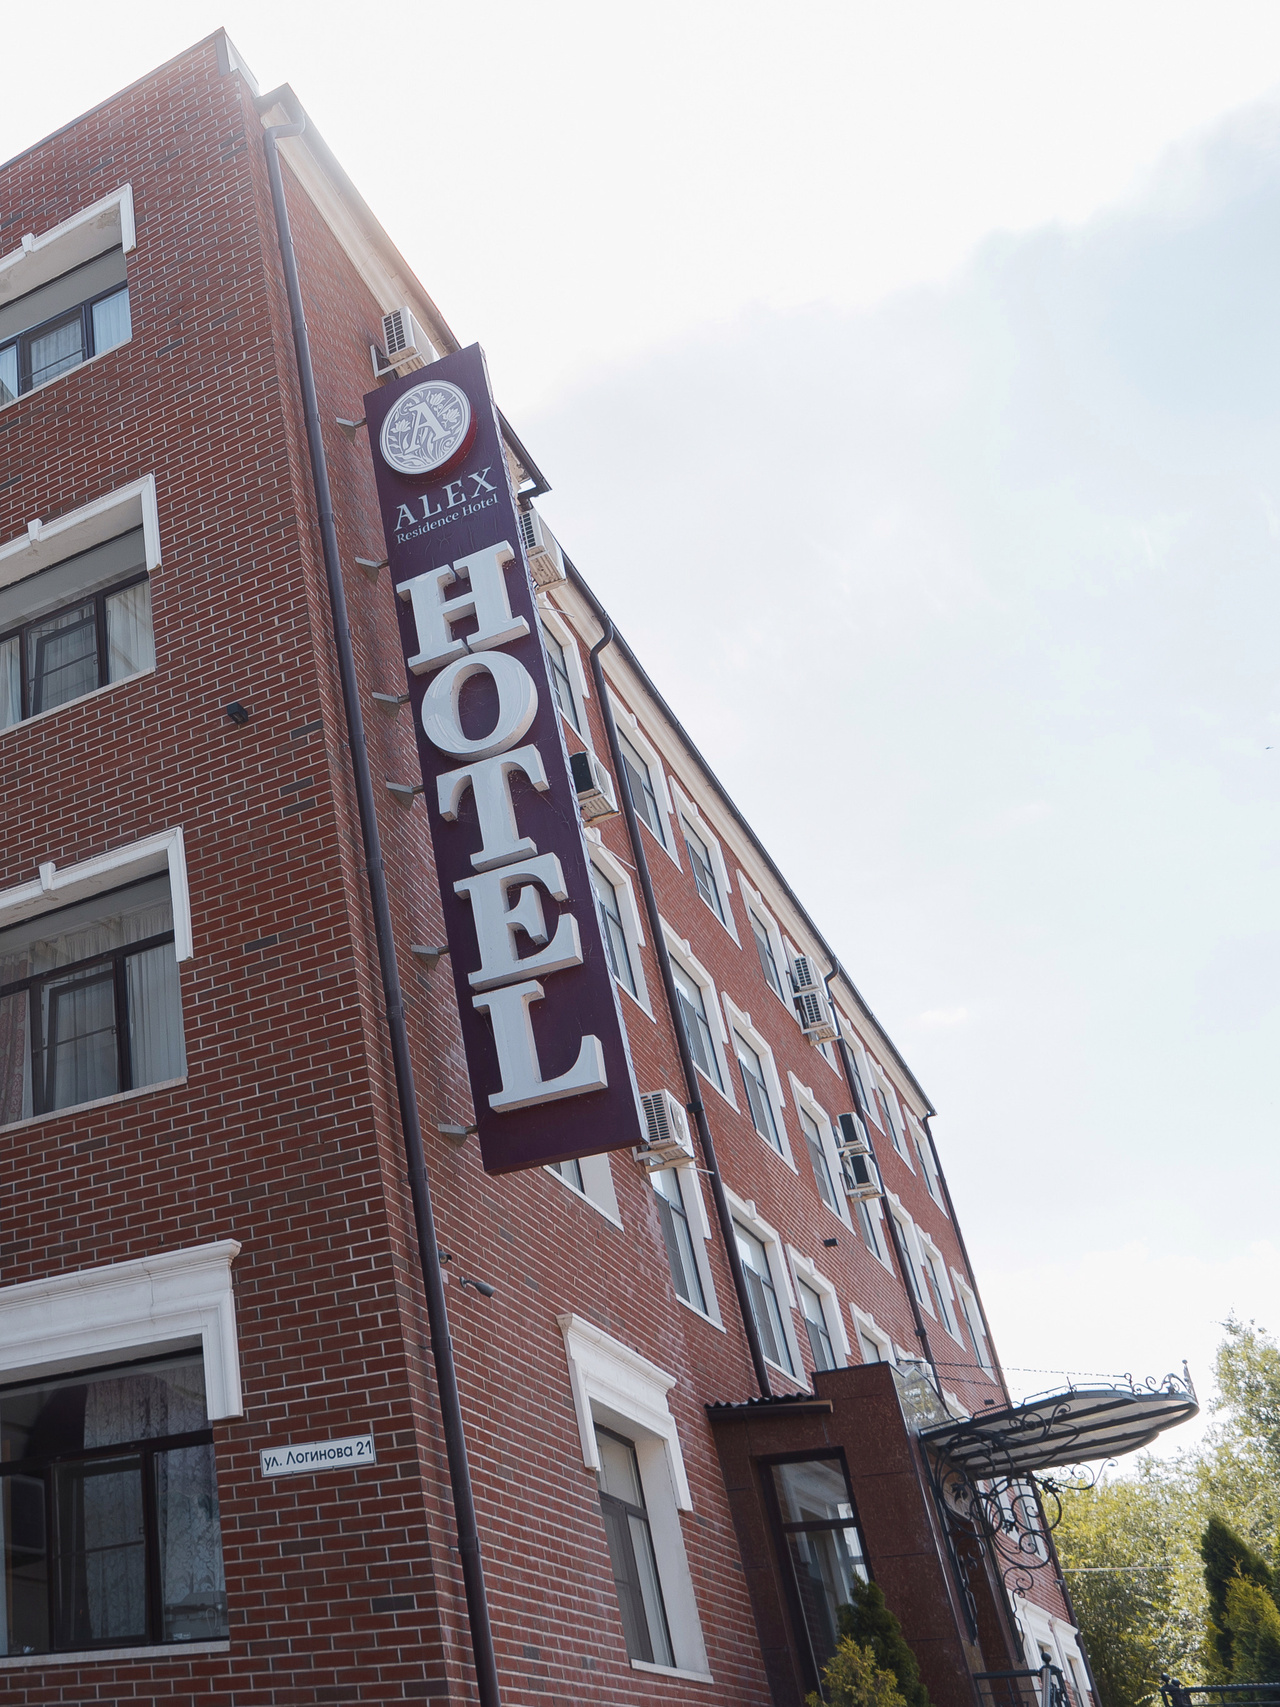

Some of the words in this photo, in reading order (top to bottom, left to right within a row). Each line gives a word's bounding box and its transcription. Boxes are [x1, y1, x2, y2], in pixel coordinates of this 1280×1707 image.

[404, 402, 451, 453] A
[393, 466, 498, 532] ALEX
[396, 511, 460, 544] Residence
[462, 493, 498, 517] Hotel
[396, 540, 608, 1113] HOTEL
[264, 1457, 283, 1471] ул.
[286, 1445, 353, 1465] Логинова
[356, 1440, 372, 1456] 21
